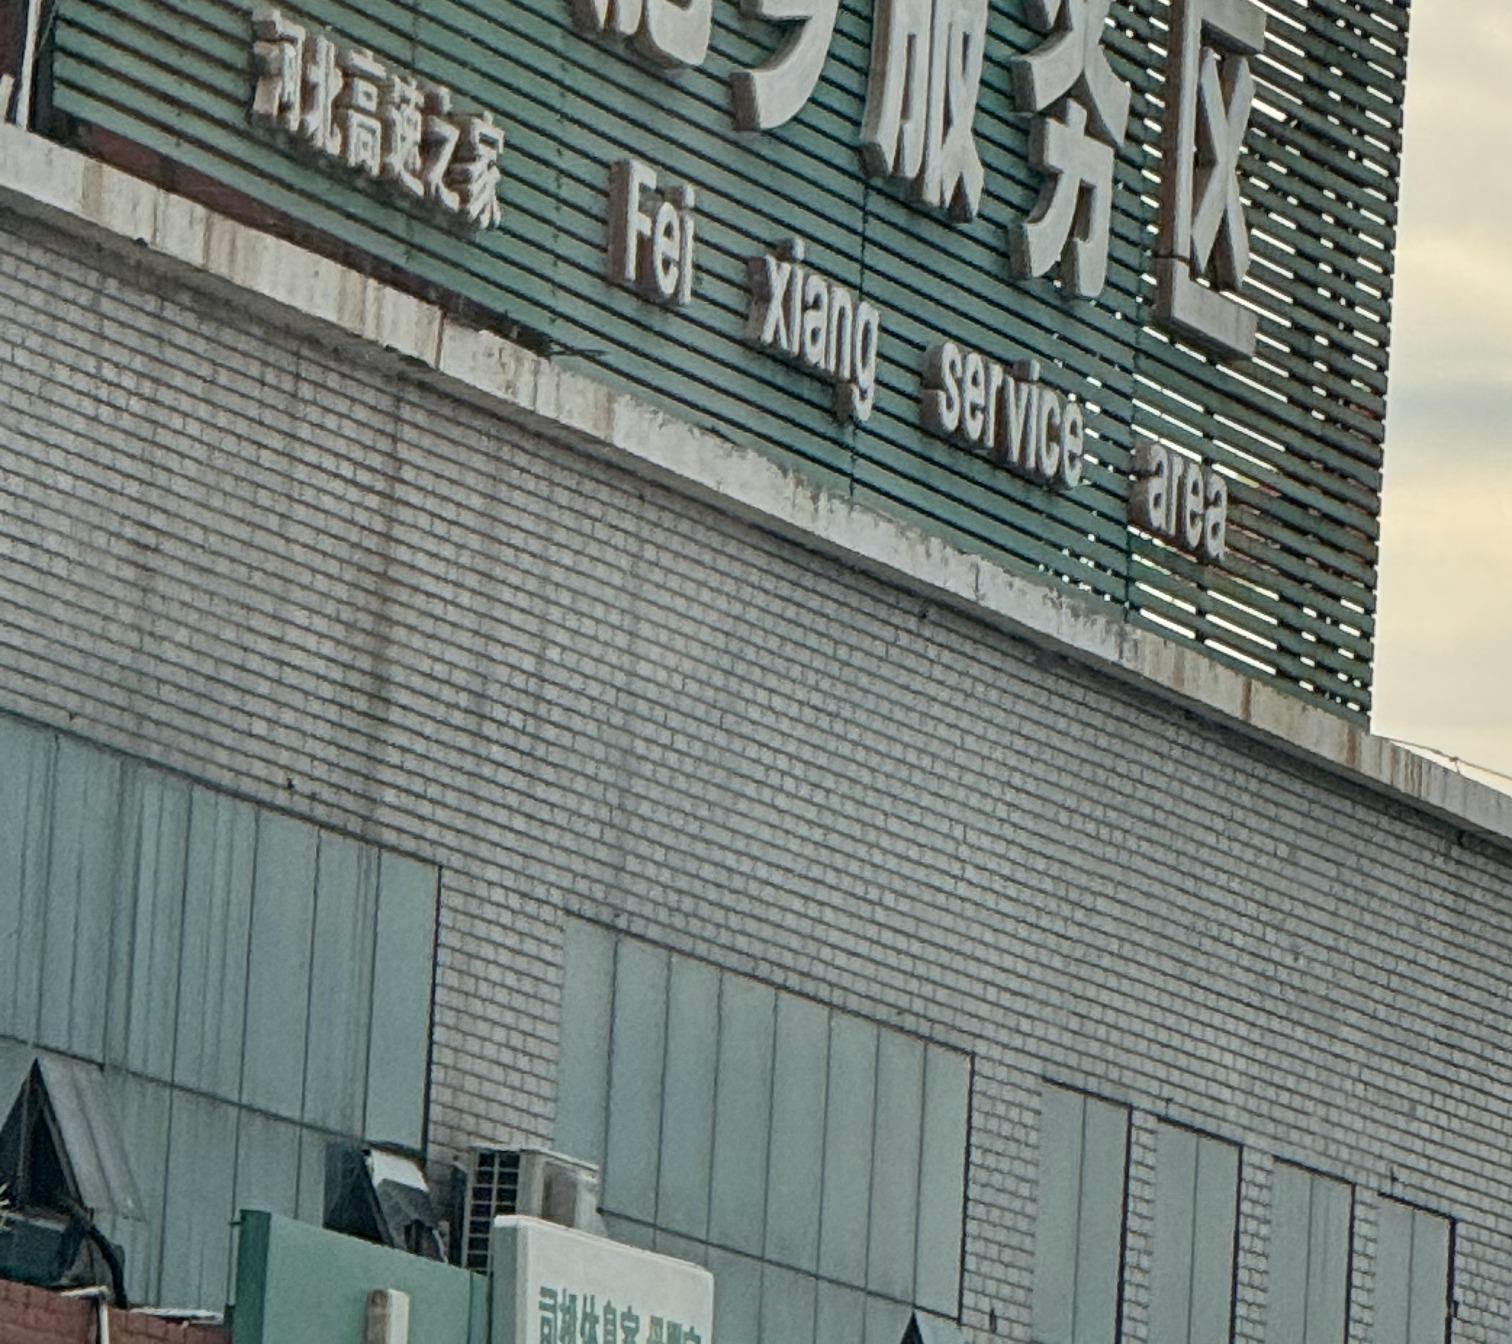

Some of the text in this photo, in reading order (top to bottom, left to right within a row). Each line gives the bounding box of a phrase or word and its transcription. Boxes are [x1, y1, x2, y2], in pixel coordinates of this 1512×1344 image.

[250, 8, 504, 232] 河北高速之家
[608, 158, 1229, 562] Fei xiang service area
